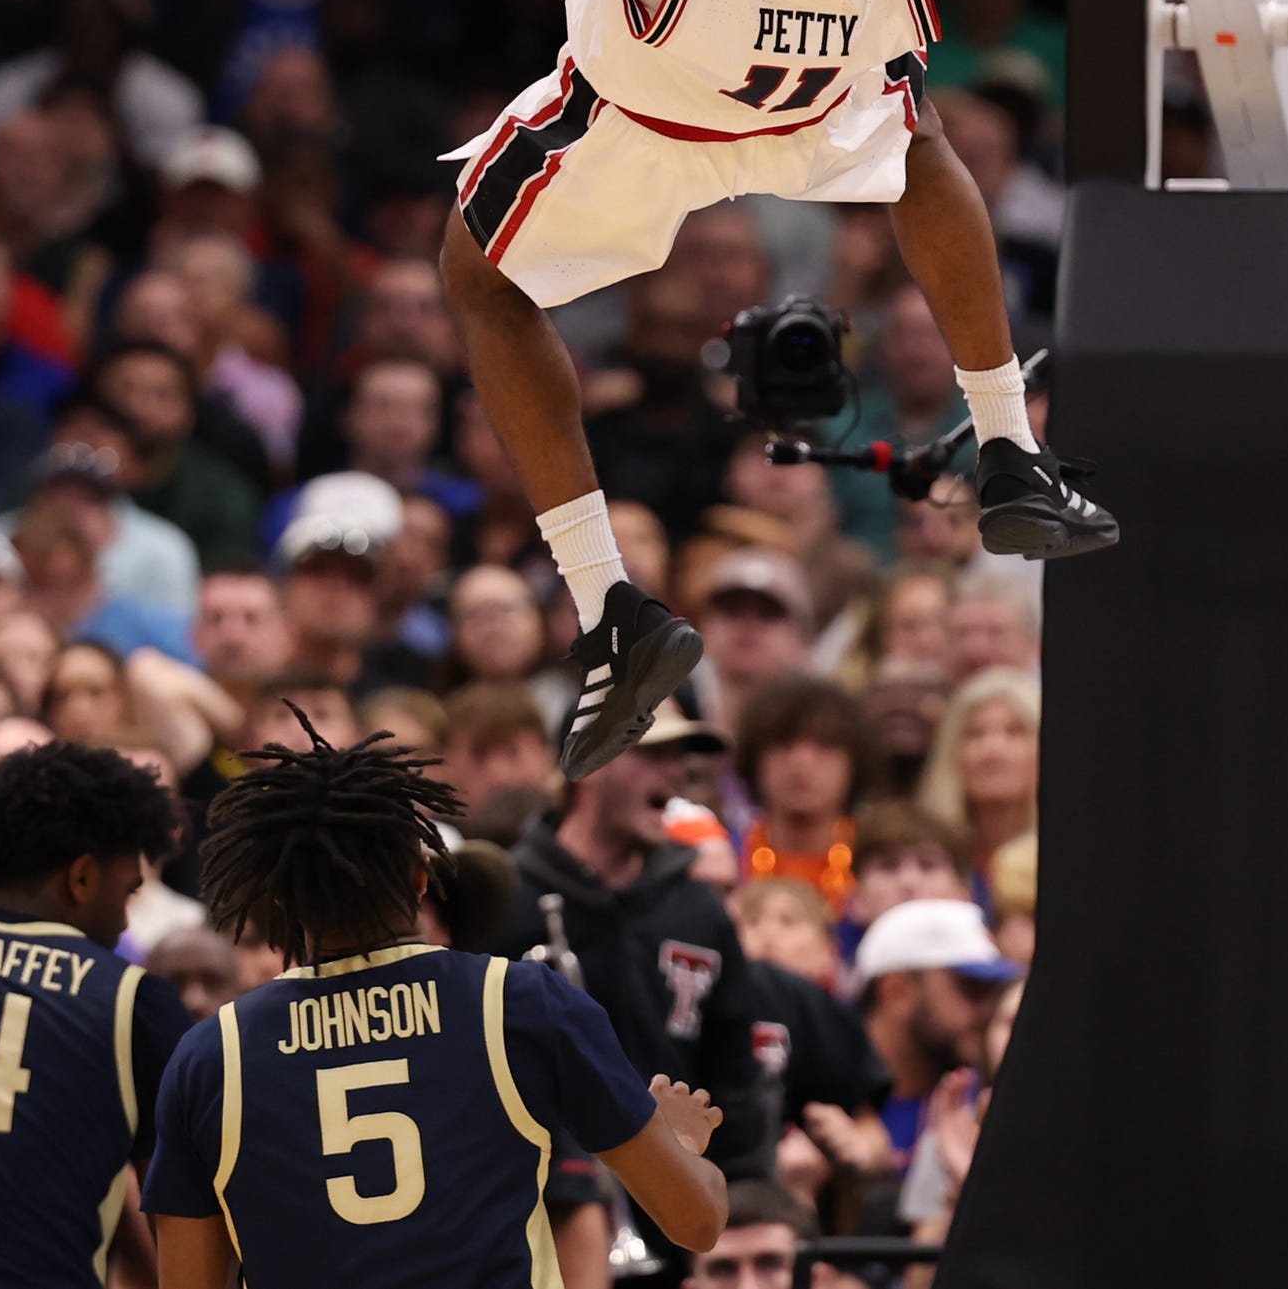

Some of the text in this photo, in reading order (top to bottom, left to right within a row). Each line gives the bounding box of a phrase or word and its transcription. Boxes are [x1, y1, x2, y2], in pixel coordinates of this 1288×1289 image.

[754, 8, 859, 56] PETTY
[718, 65, 842, 113] 11
[278, 980, 441, 1054] JOHNSON
[316, 1058, 426, 1225] 5
